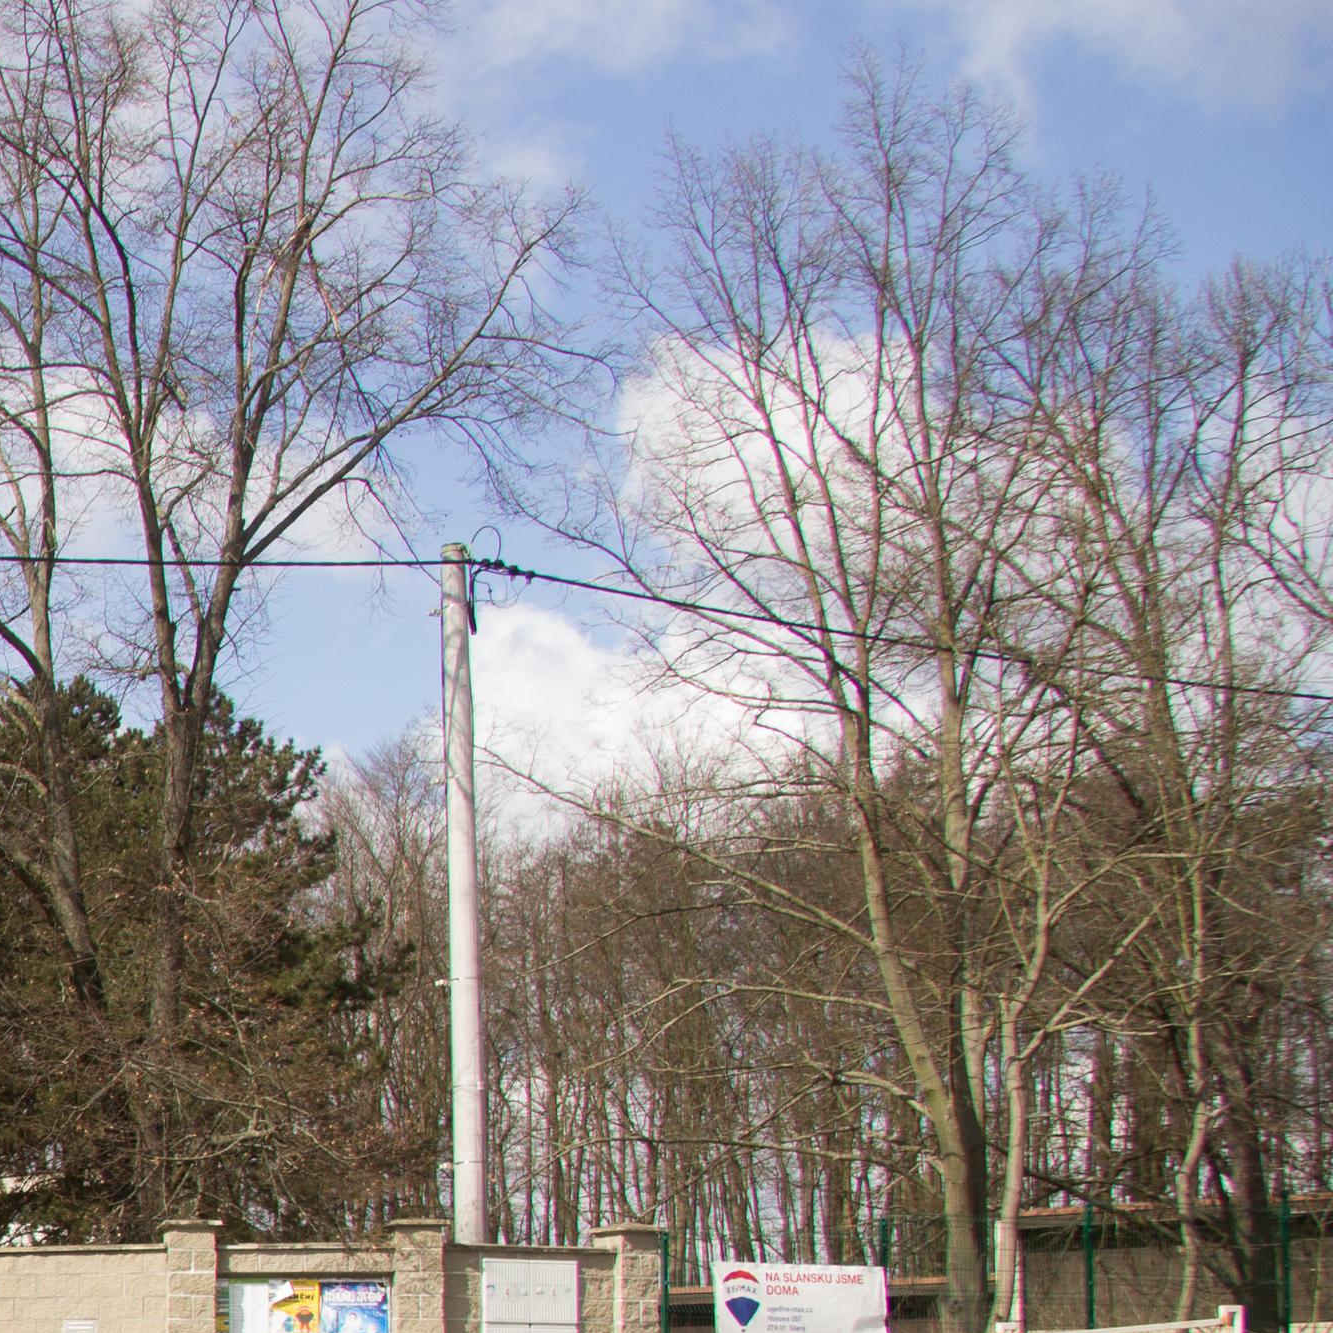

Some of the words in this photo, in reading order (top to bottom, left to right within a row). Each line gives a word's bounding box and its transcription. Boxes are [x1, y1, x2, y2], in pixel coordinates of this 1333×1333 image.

[765, 1272, 780, 1282] NA
[836, 1273, 864, 1285] JSME
[726, 1284, 758, 1296] RE/MAX
[766, 1284, 799, 1296] DOMA
